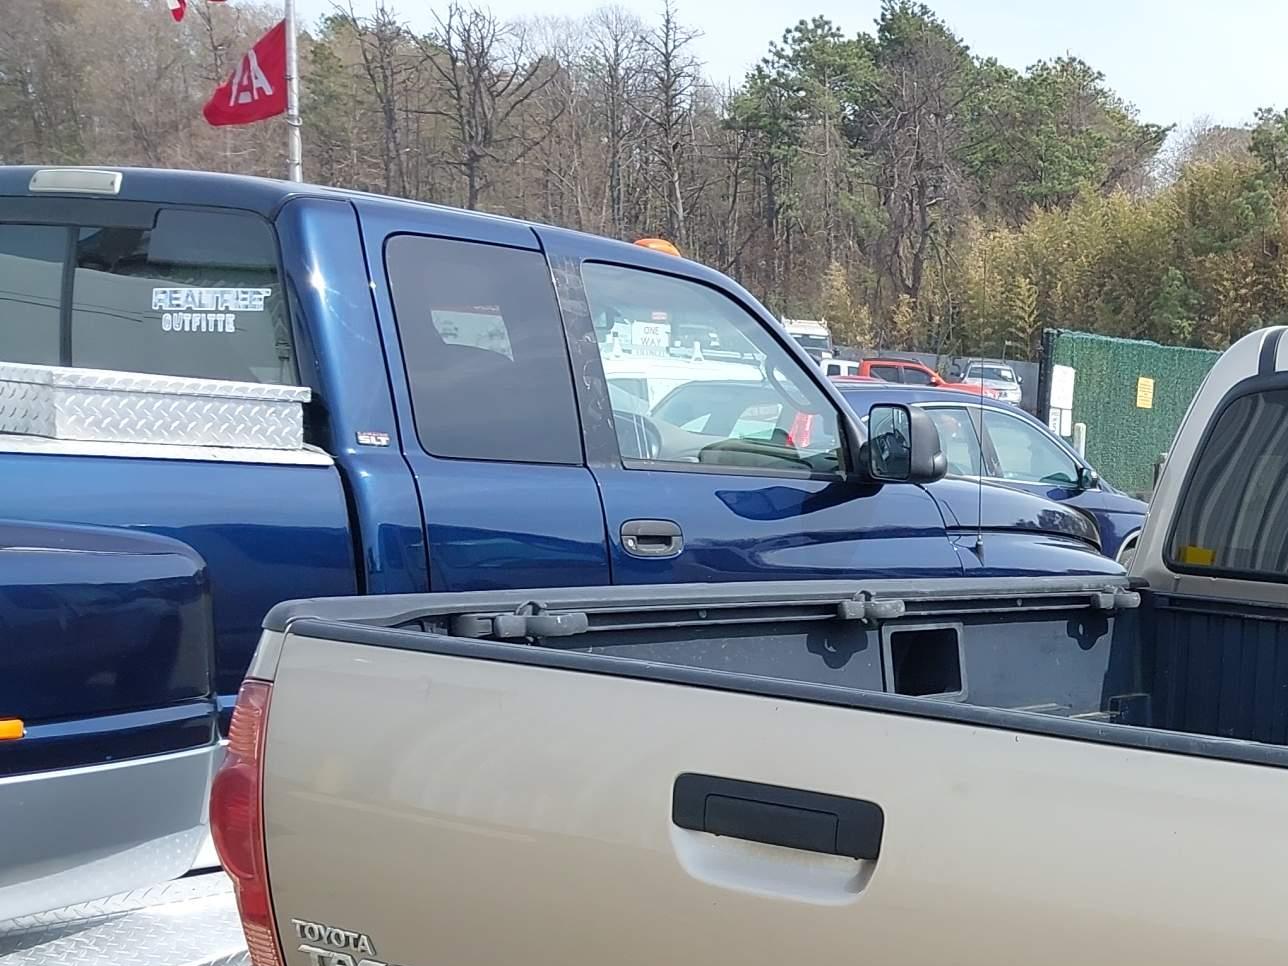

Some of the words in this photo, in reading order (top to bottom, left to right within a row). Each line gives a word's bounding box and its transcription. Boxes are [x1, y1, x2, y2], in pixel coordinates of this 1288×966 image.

[152, 287, 271, 311] REALTREE
[643, 326, 660, 336] ONE
[357, 435, 390, 446] SLT
[291, 918, 377, 956] TOYOTA
